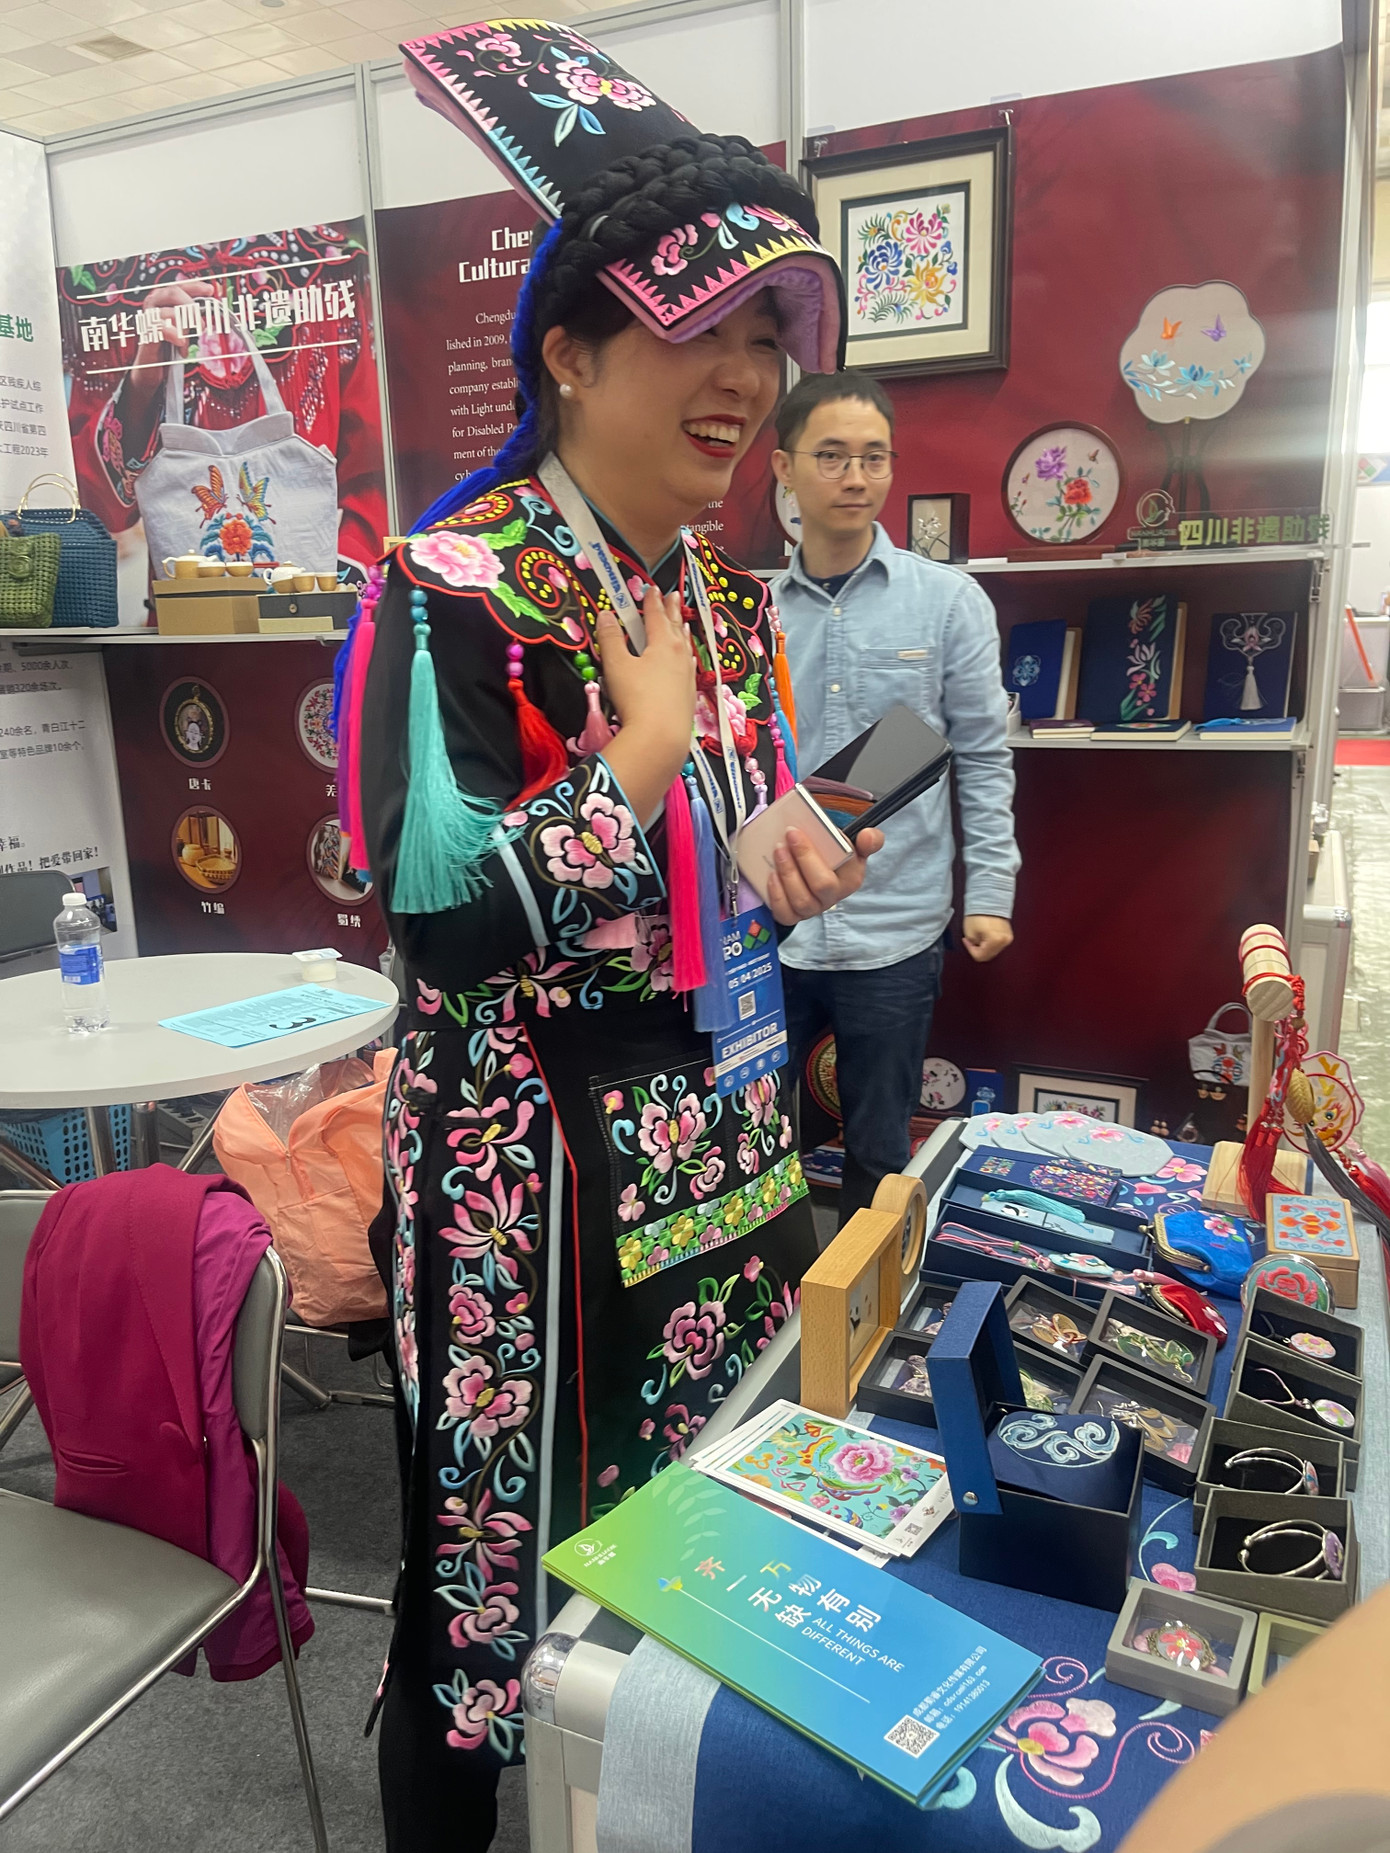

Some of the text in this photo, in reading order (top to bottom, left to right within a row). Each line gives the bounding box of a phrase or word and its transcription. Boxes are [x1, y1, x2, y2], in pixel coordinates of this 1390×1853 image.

[475, 309, 517, 325] Chengdu
[446, 337, 472, 350] lished
[473, 336, 482, 347] in
[449, 383, 489, 396] company
[450, 405, 469, 416] with
[471, 402, 494, 417] Light
[452, 427, 464, 438] for
[467, 423, 504, 437] Disabled
[454, 450, 475, 459] ment
[477, 446, 487, 457] of
[722, 1022, 778, 1059] EXHIBITOR
[801, 1626, 866, 1666] DIFFERENT
[812, 1617, 905, 1673] ALL THINGS ARE
